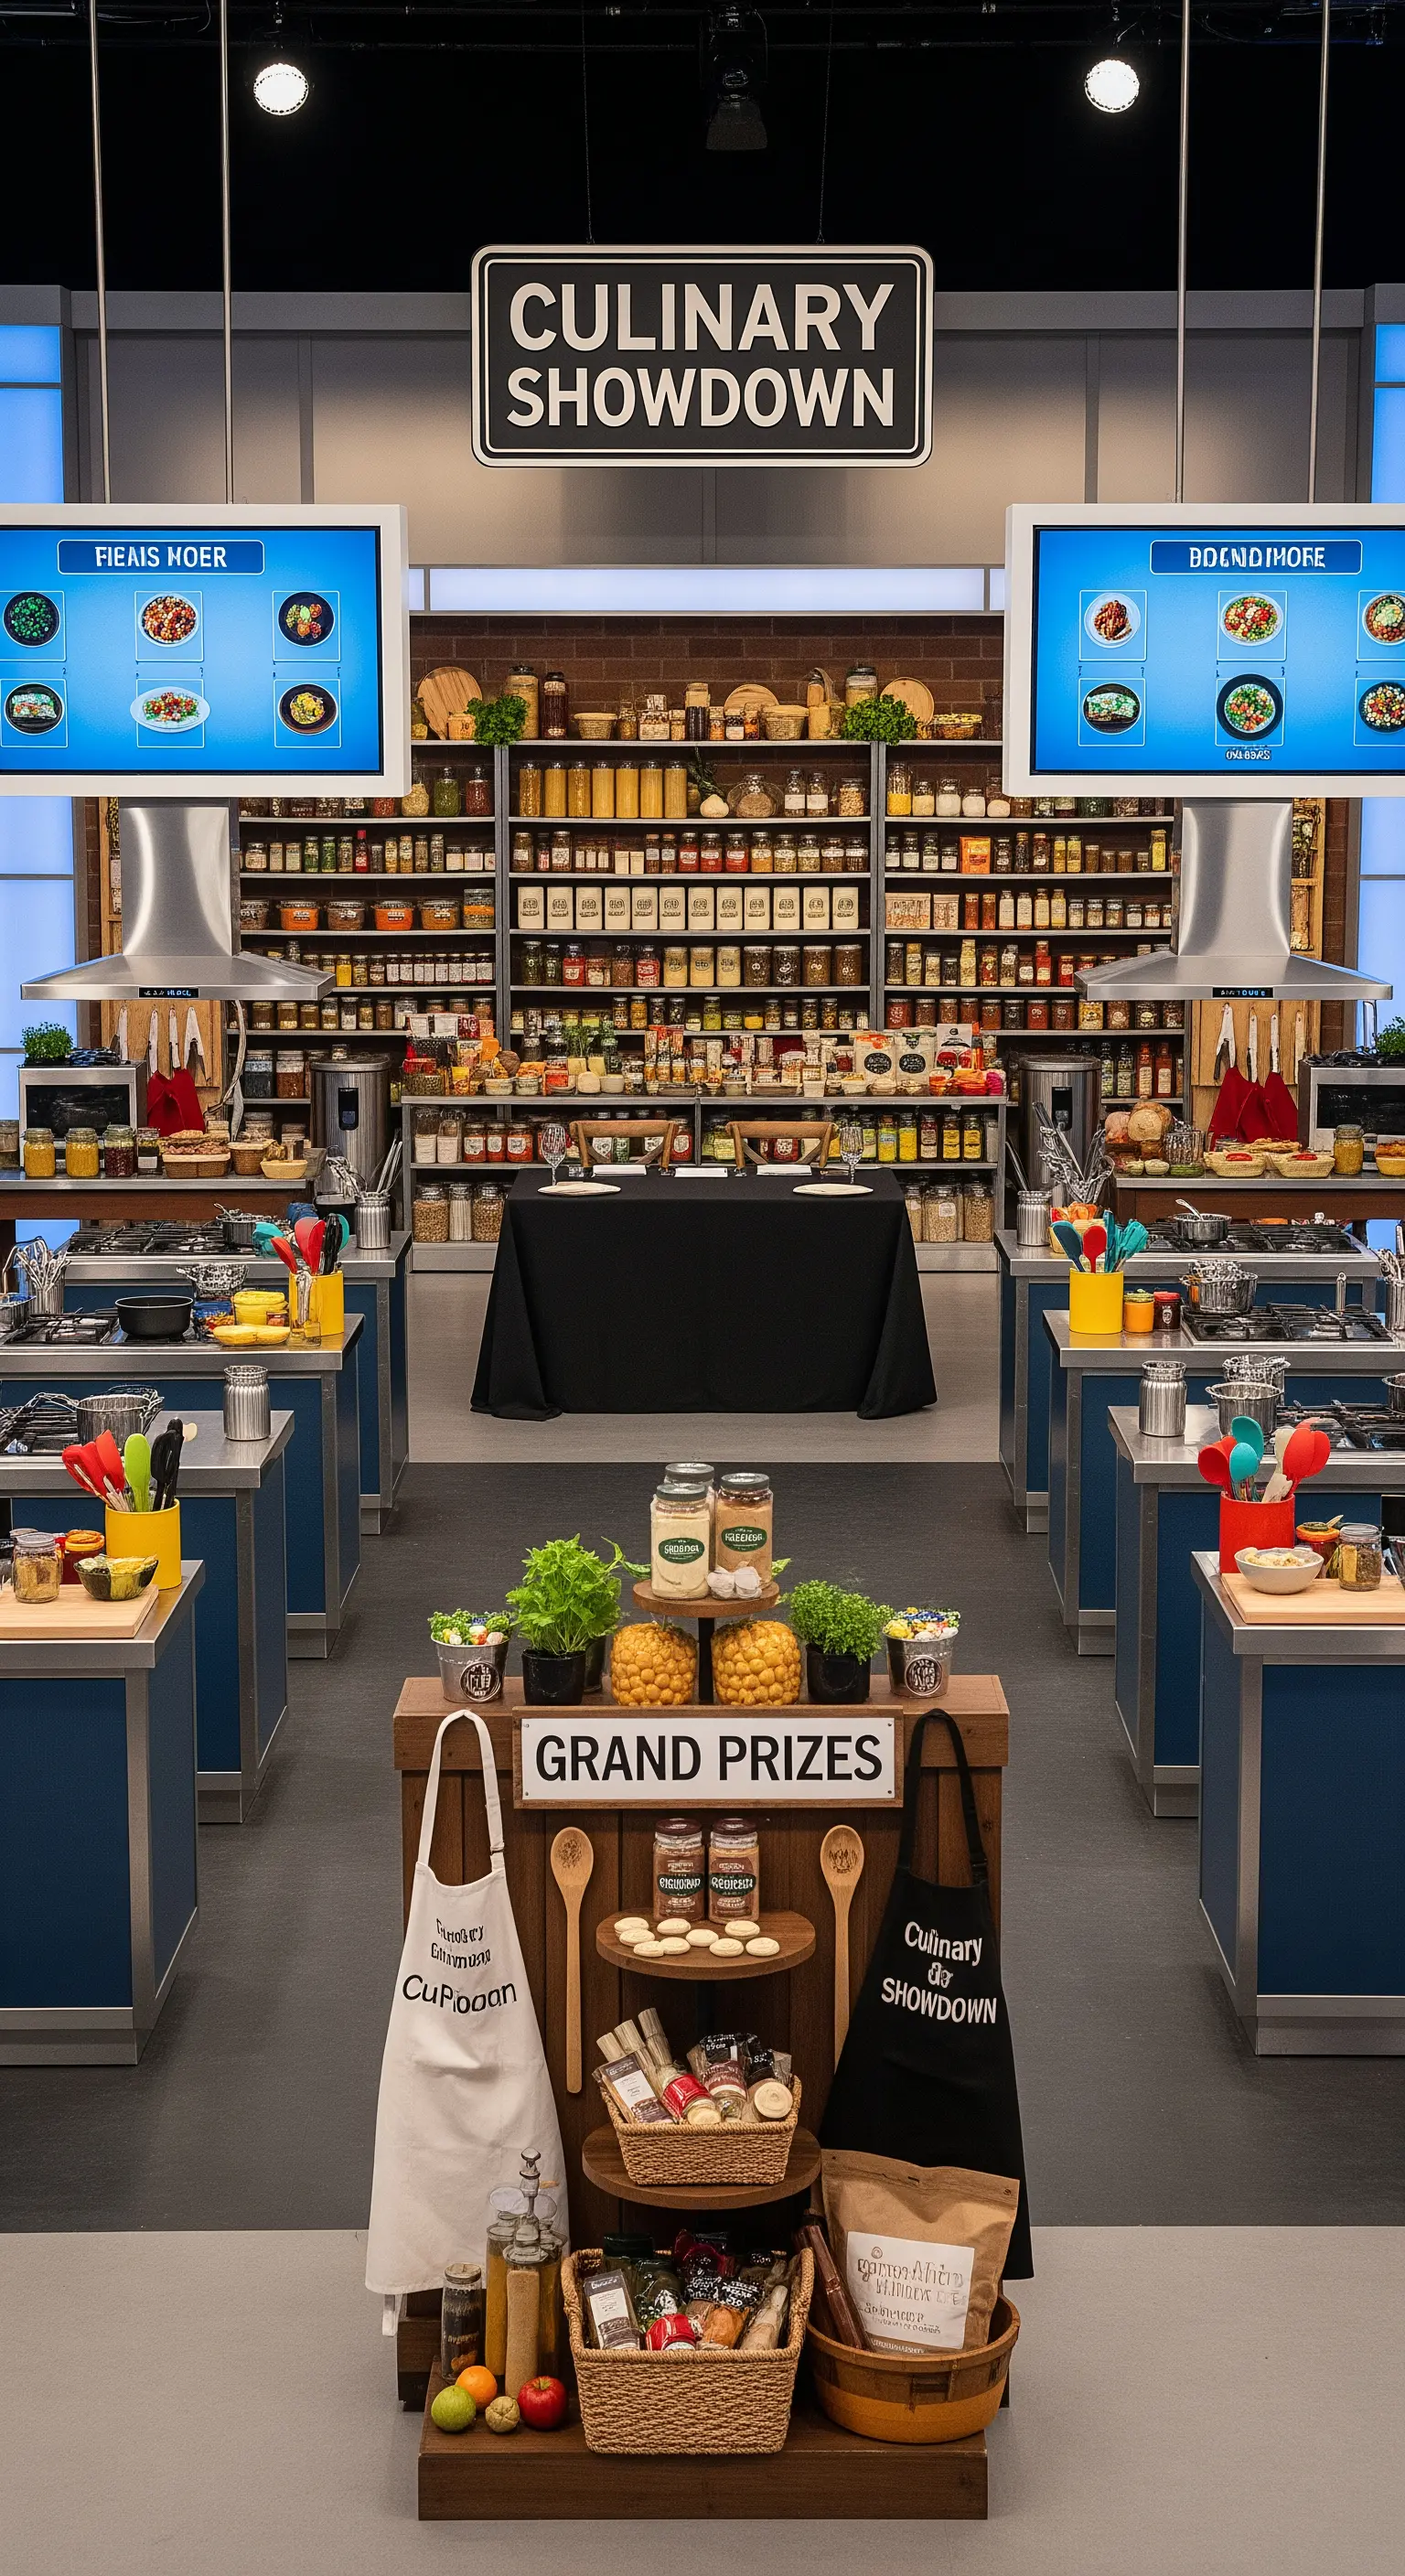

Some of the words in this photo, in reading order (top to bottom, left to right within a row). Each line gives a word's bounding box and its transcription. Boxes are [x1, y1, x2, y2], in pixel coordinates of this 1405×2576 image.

[509, 282, 895, 352] CULINARY
[506, 367, 895, 427] SHOWDOWN
[535, 1734, 702, 1782] GRAND
[718, 1734, 883, 1782] PRIZES
[904, 1921, 982, 1967] Culinary
[881, 1977, 997, 2023] SHOWDOWN
